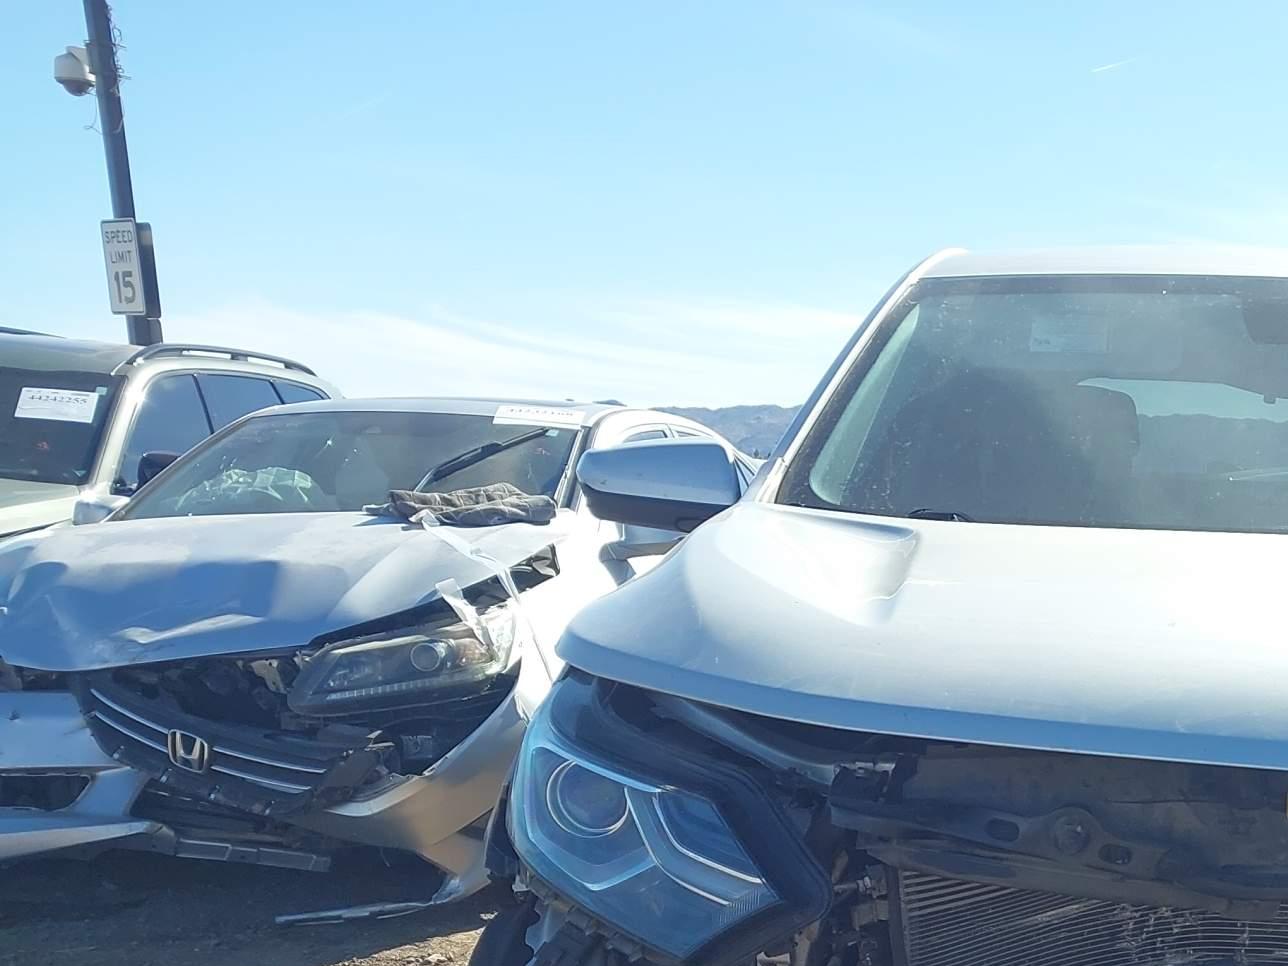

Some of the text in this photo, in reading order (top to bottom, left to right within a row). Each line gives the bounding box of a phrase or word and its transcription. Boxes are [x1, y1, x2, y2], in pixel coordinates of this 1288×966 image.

[104, 229, 133, 244] SPEED
[109, 250, 132, 264] LIMIT
[114, 270, 136, 304] 15
